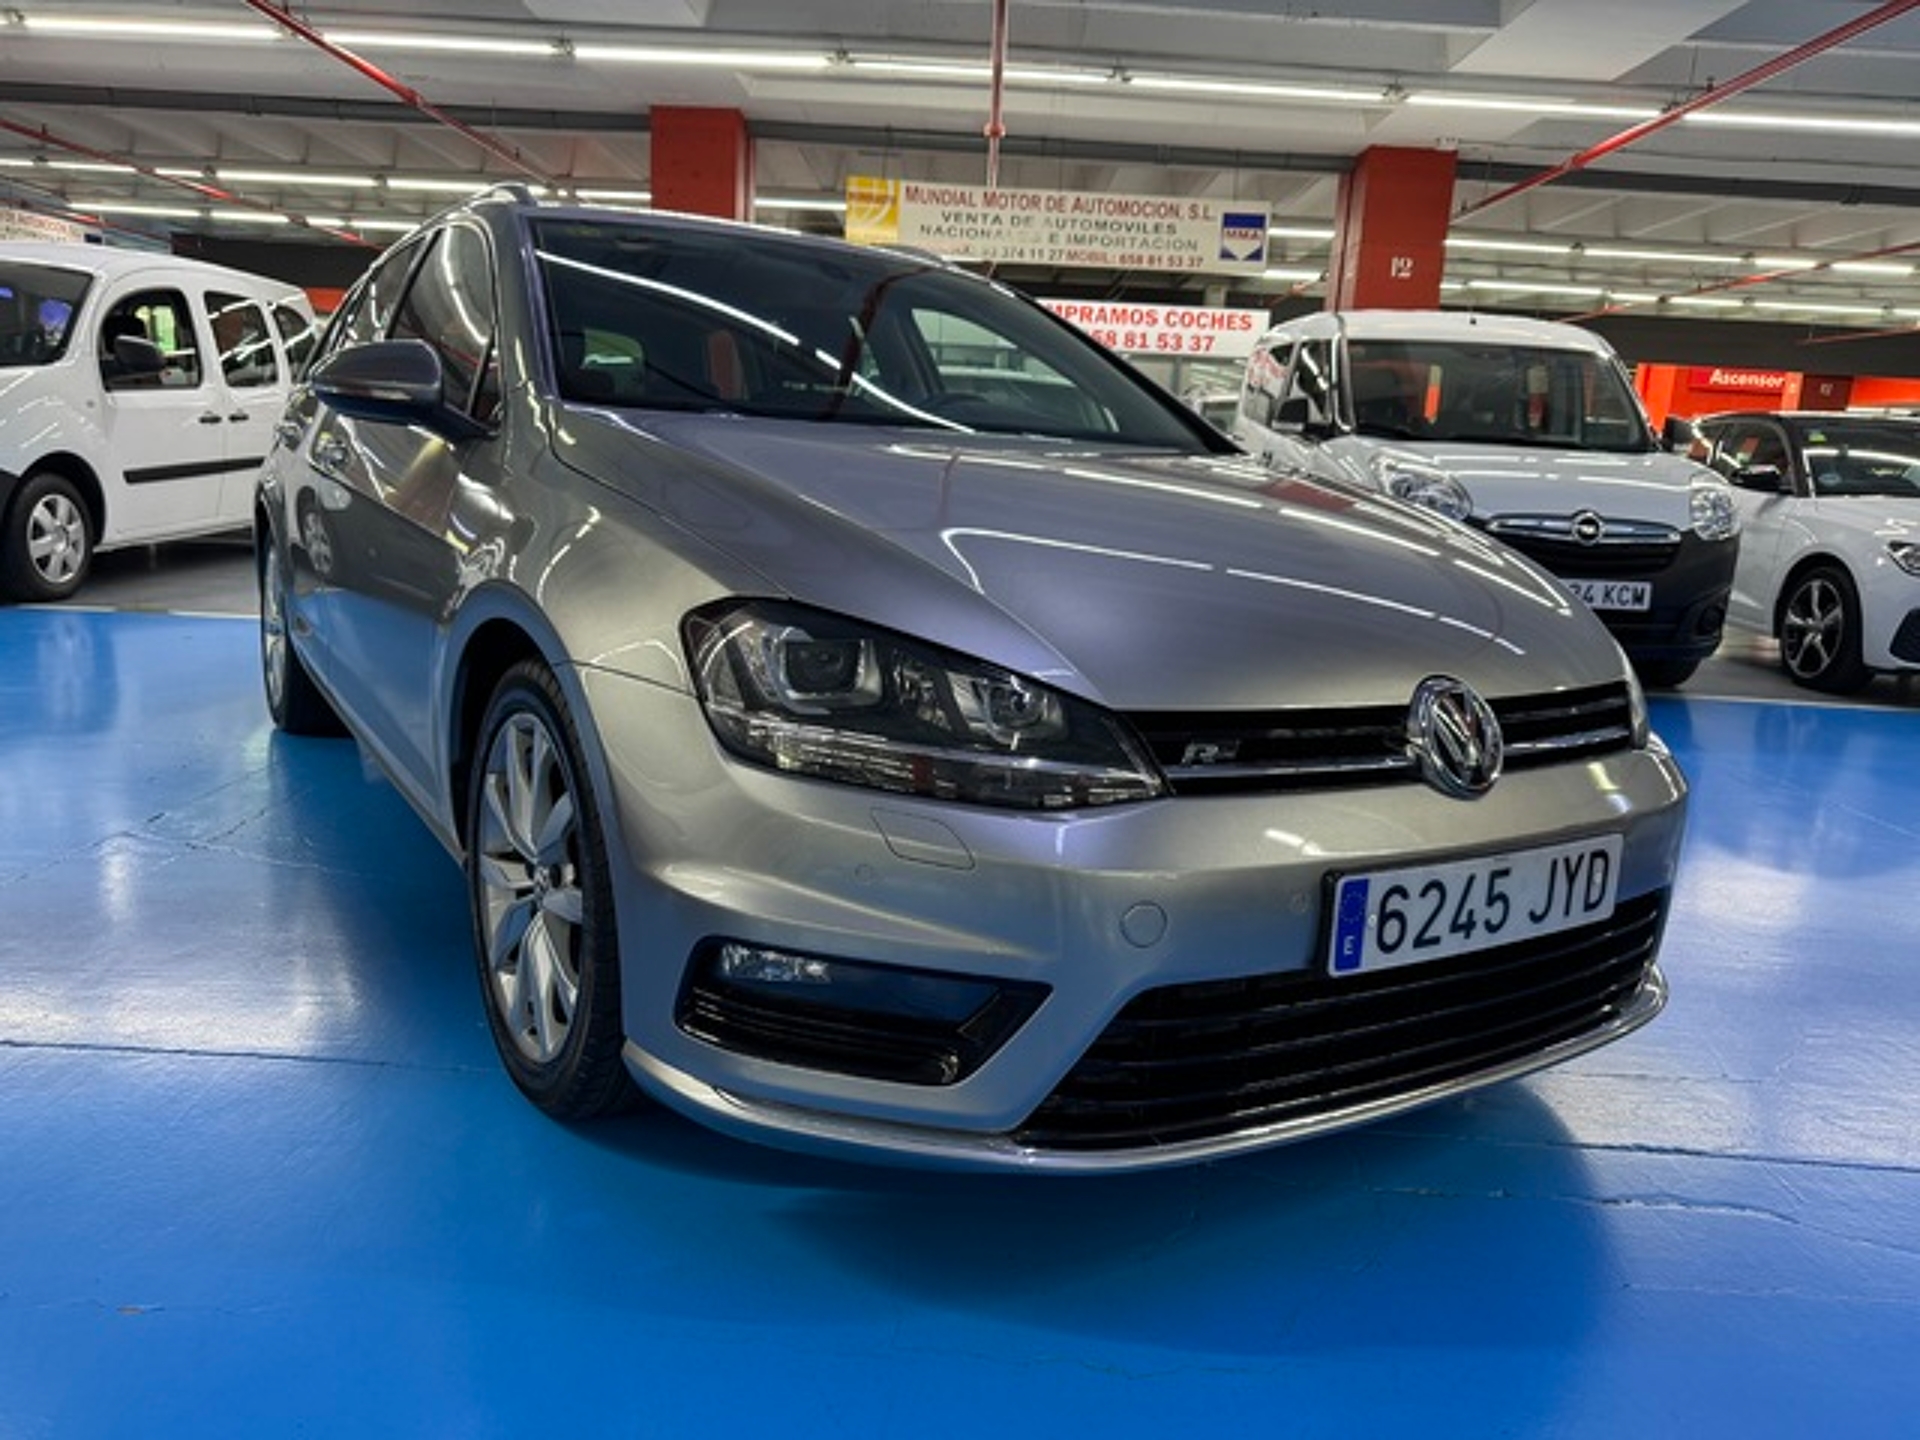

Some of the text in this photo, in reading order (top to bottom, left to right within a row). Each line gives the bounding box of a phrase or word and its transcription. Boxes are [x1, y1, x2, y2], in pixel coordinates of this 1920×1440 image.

[905, 185, 976, 208] MUNDIAL
[983, 191, 1041, 212] MOTOR
[1045, 196, 1065, 213] DE
[942, 212, 1177, 235] VENTA DE AUTOMOVILES
[1049, 233, 1059, 243] E
[1066, 234, 1199, 251] IMPORTACION
[1164, 310, 1252, 331] COCHES
[1124, 331, 1149, 349] 81
[1156, 334, 1183, 351] 53
[1190, 335, 1215, 351] 37
[1709, 369, 1784, 388] Ascensor
[1602, 584, 1645, 606] KCW
[1376, 850, 1610, 954] 6245 JYD
[1343, 936, 1354, 955] E
